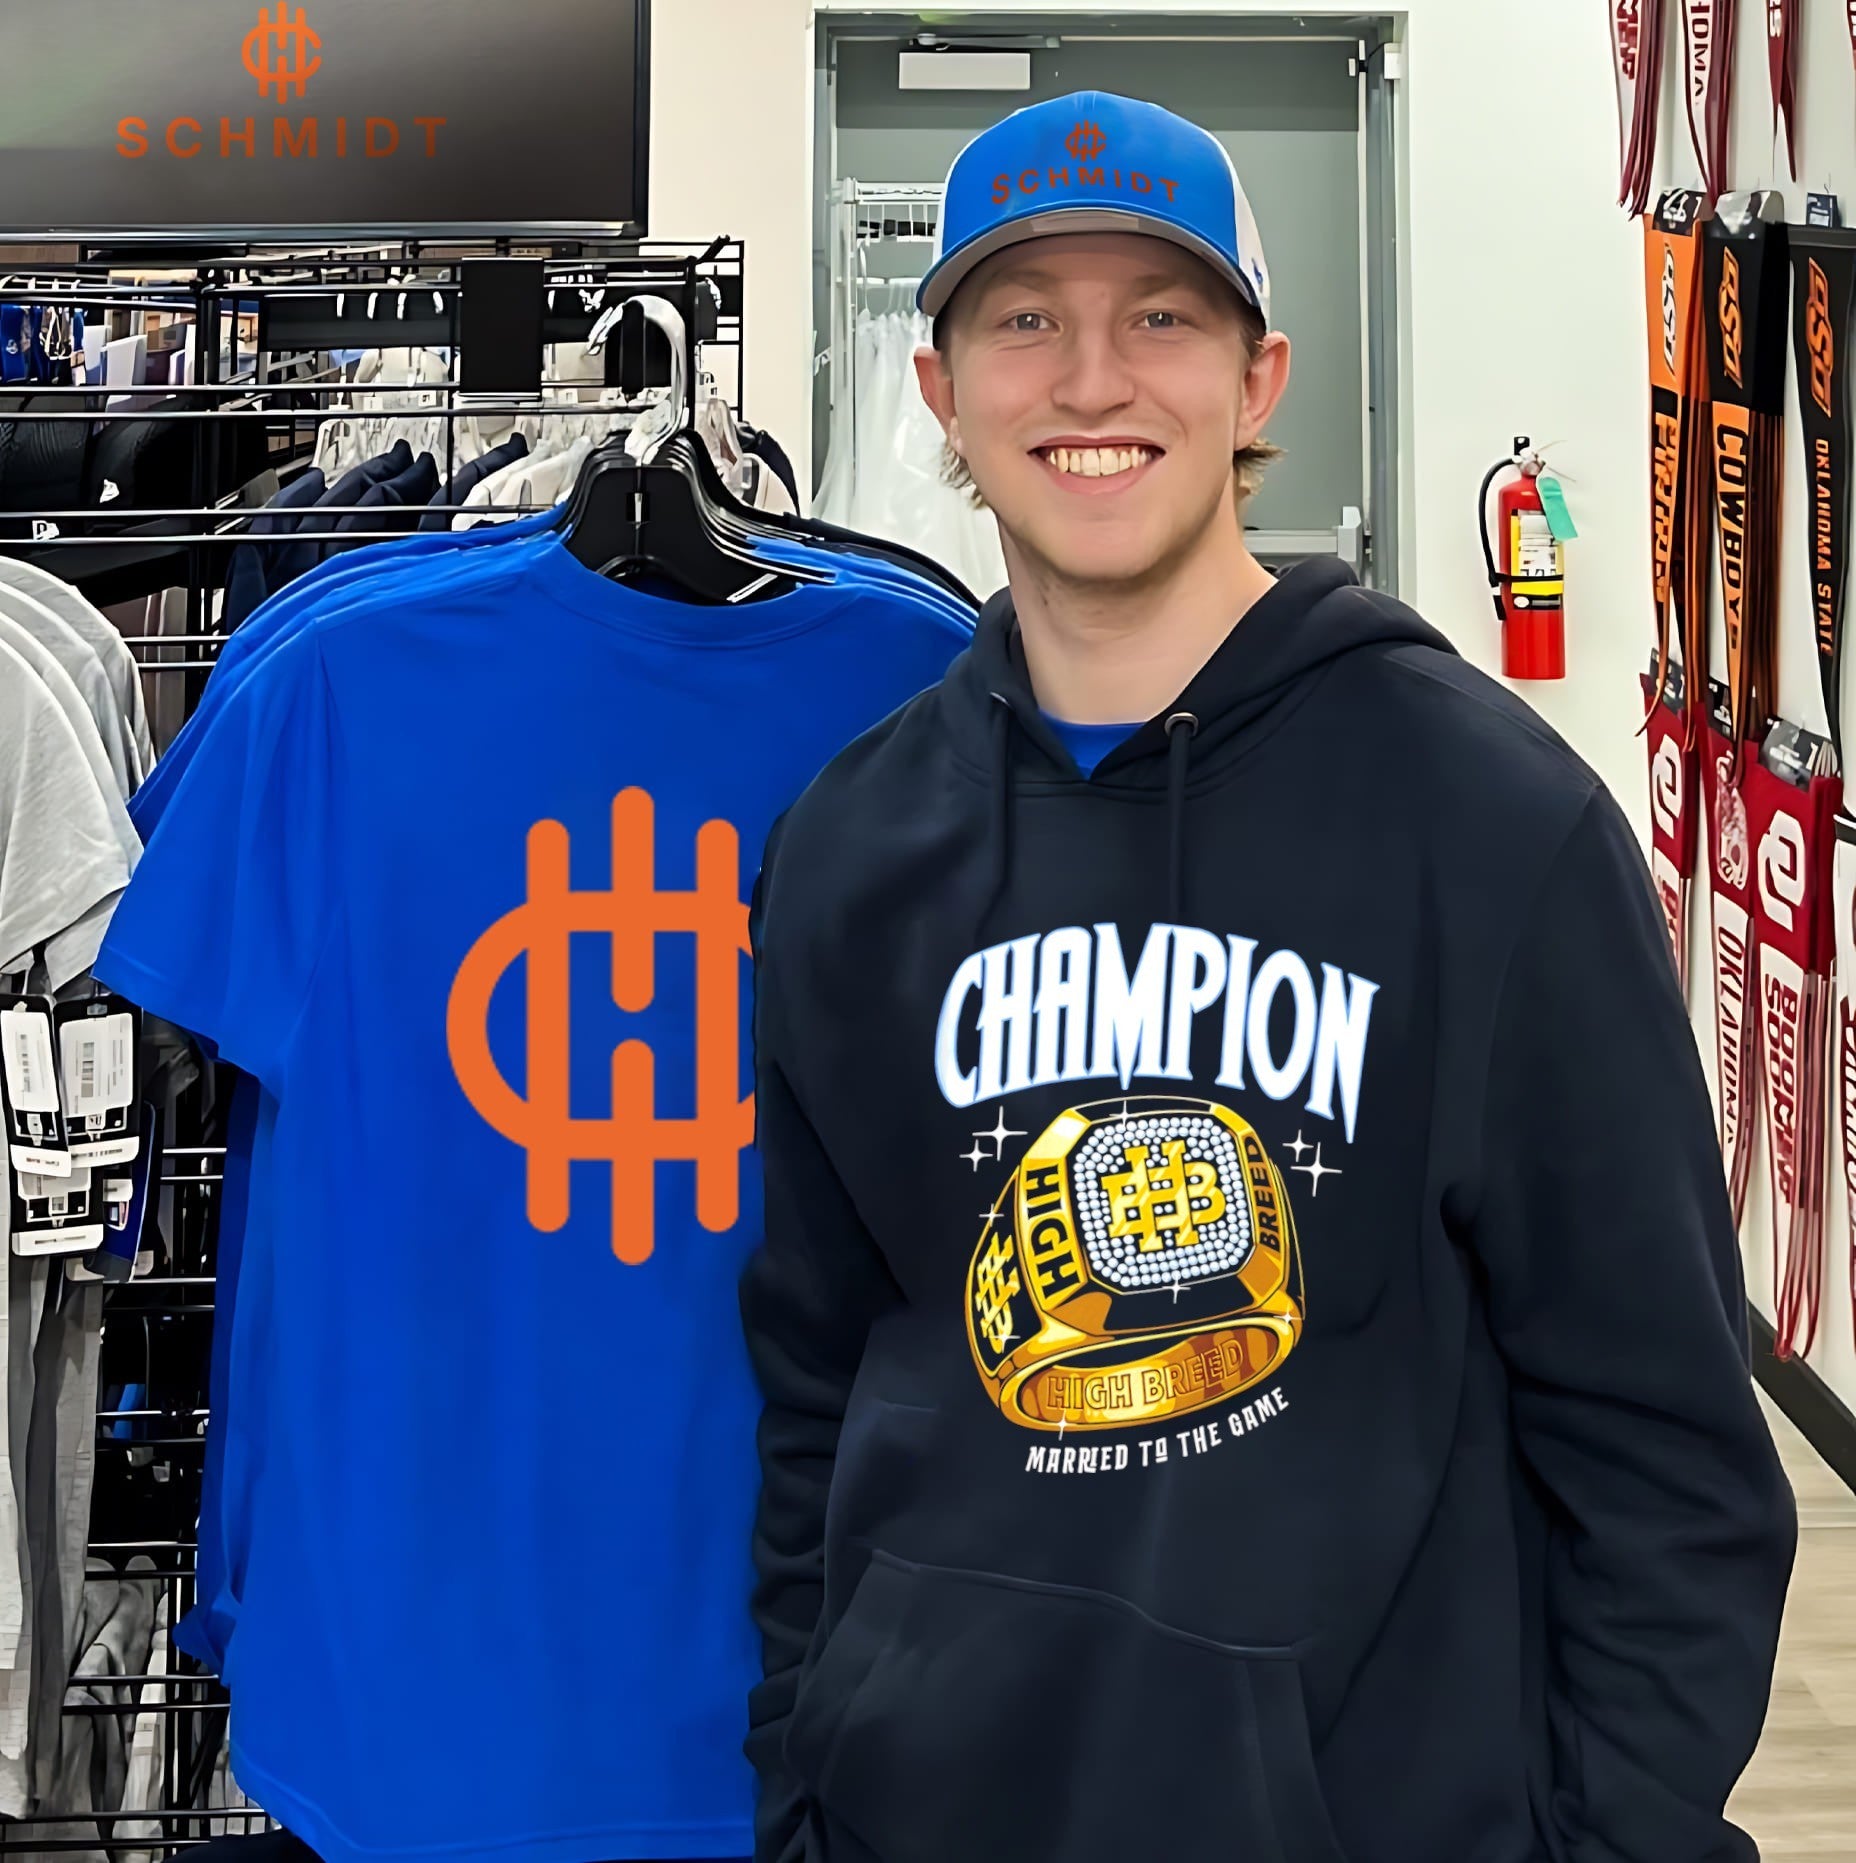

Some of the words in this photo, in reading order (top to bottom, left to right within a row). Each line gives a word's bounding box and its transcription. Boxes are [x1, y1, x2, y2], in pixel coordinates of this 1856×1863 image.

[115, 116, 447, 158] SCHMIDT
[992, 167, 1178, 204] SCHMIDT
[1815, 439, 1832, 570] OKLAHOMA
[935, 922, 1380, 1144] CHAMPION
[1026, 1164, 1081, 1300] HIGH
[1244, 1135, 1281, 1253] BREED
[1047, 1373, 1133, 1410] HIGH
[1142, 1339, 1244, 1404] BREED
[1025, 1444, 1128, 1474] MARRIED
[1138, 1437, 1168, 1467] TO
[1176, 1422, 1222, 1457] THE
[1228, 1387, 1289, 1437] GAME
